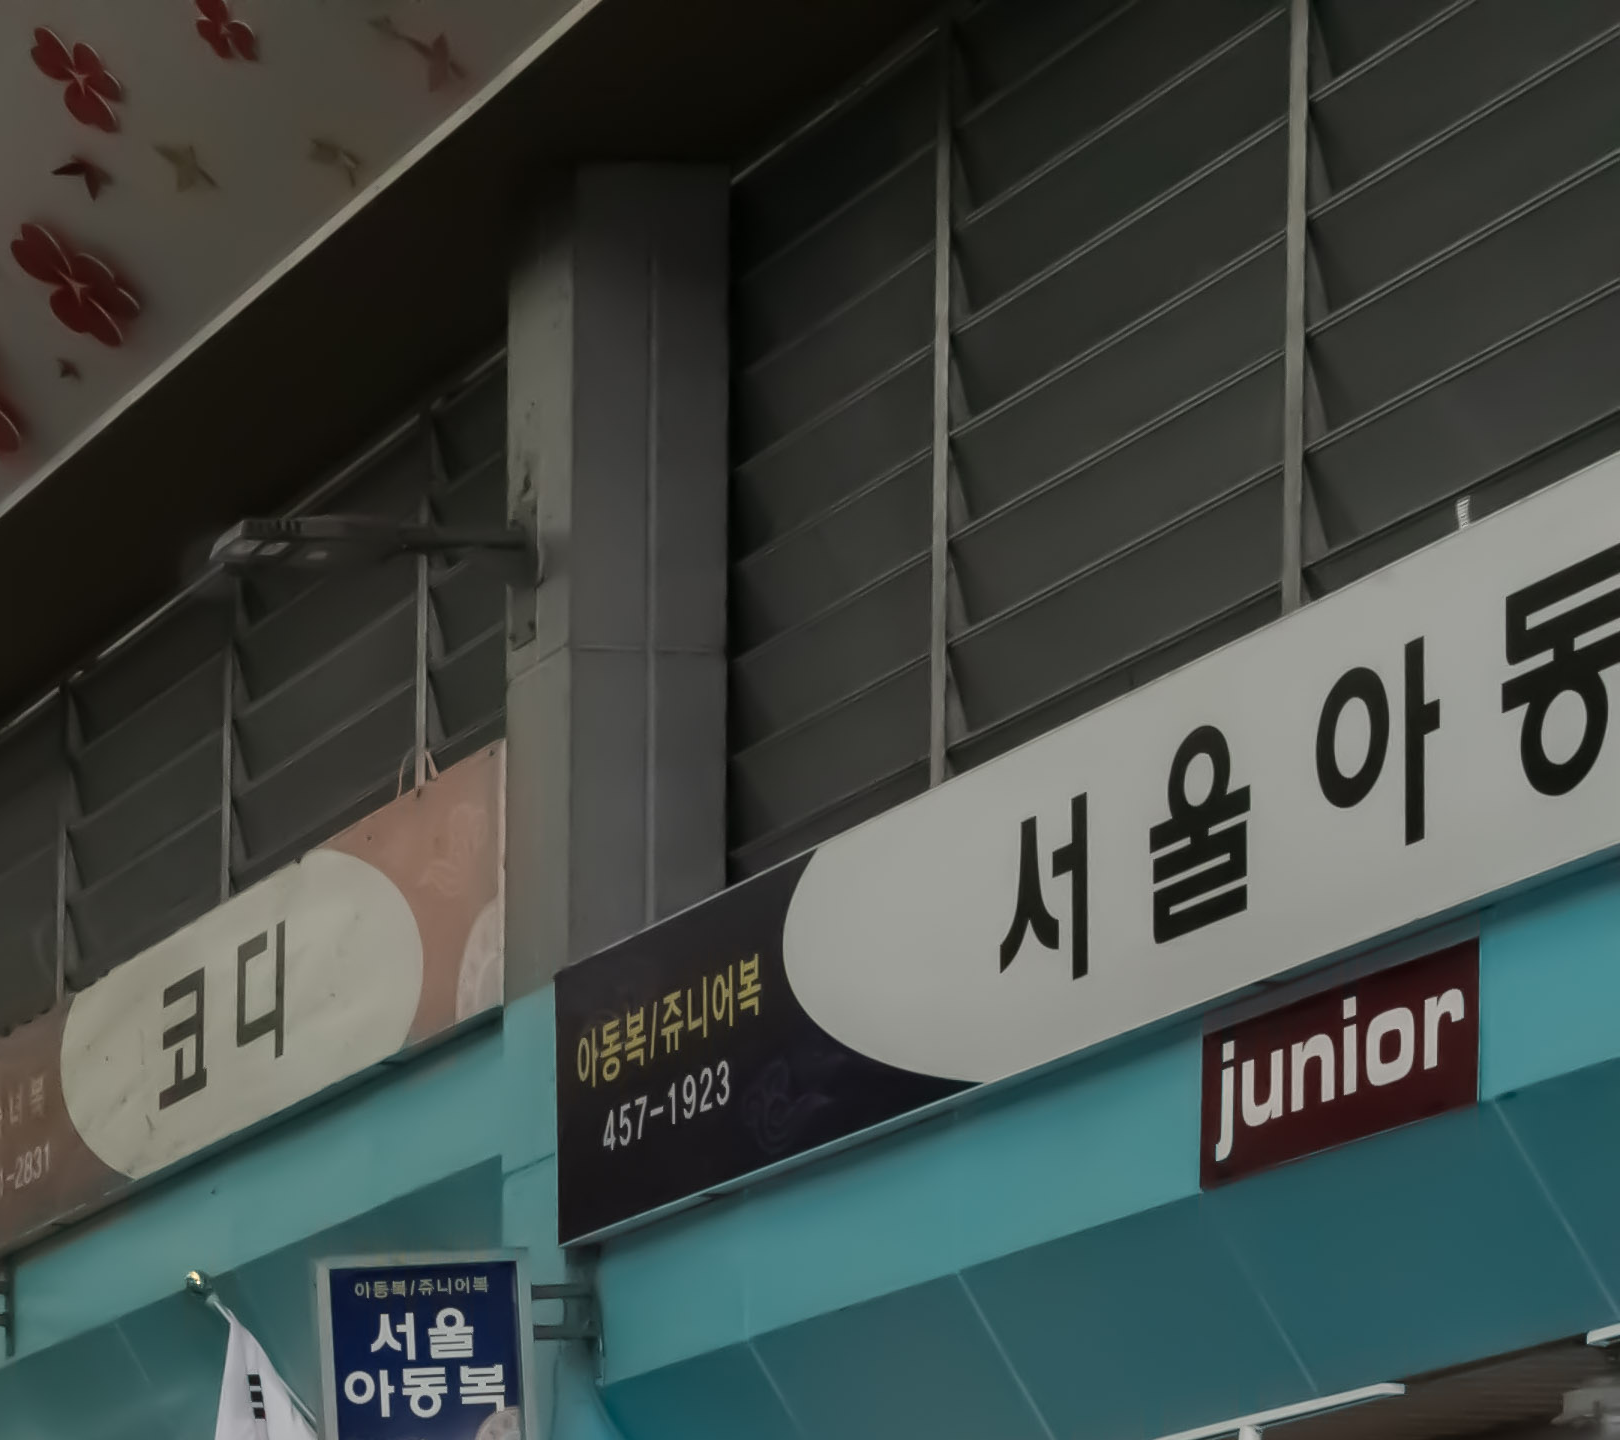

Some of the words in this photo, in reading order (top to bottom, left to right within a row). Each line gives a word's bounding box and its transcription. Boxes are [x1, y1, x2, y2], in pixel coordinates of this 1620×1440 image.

[158, 920, 286, 1110] 코디
[576, 953, 763, 1090] 아동복/쥬니어복
[602, 1062, 732, 1152] 457-1923
[1213, 985, 1466, 1162] junior
[353, 1276, 489, 1299] 아동복/쥬니어복
[370, 1307, 474, 1361] 서울
[344, 1365, 506, 1420] 아동복
